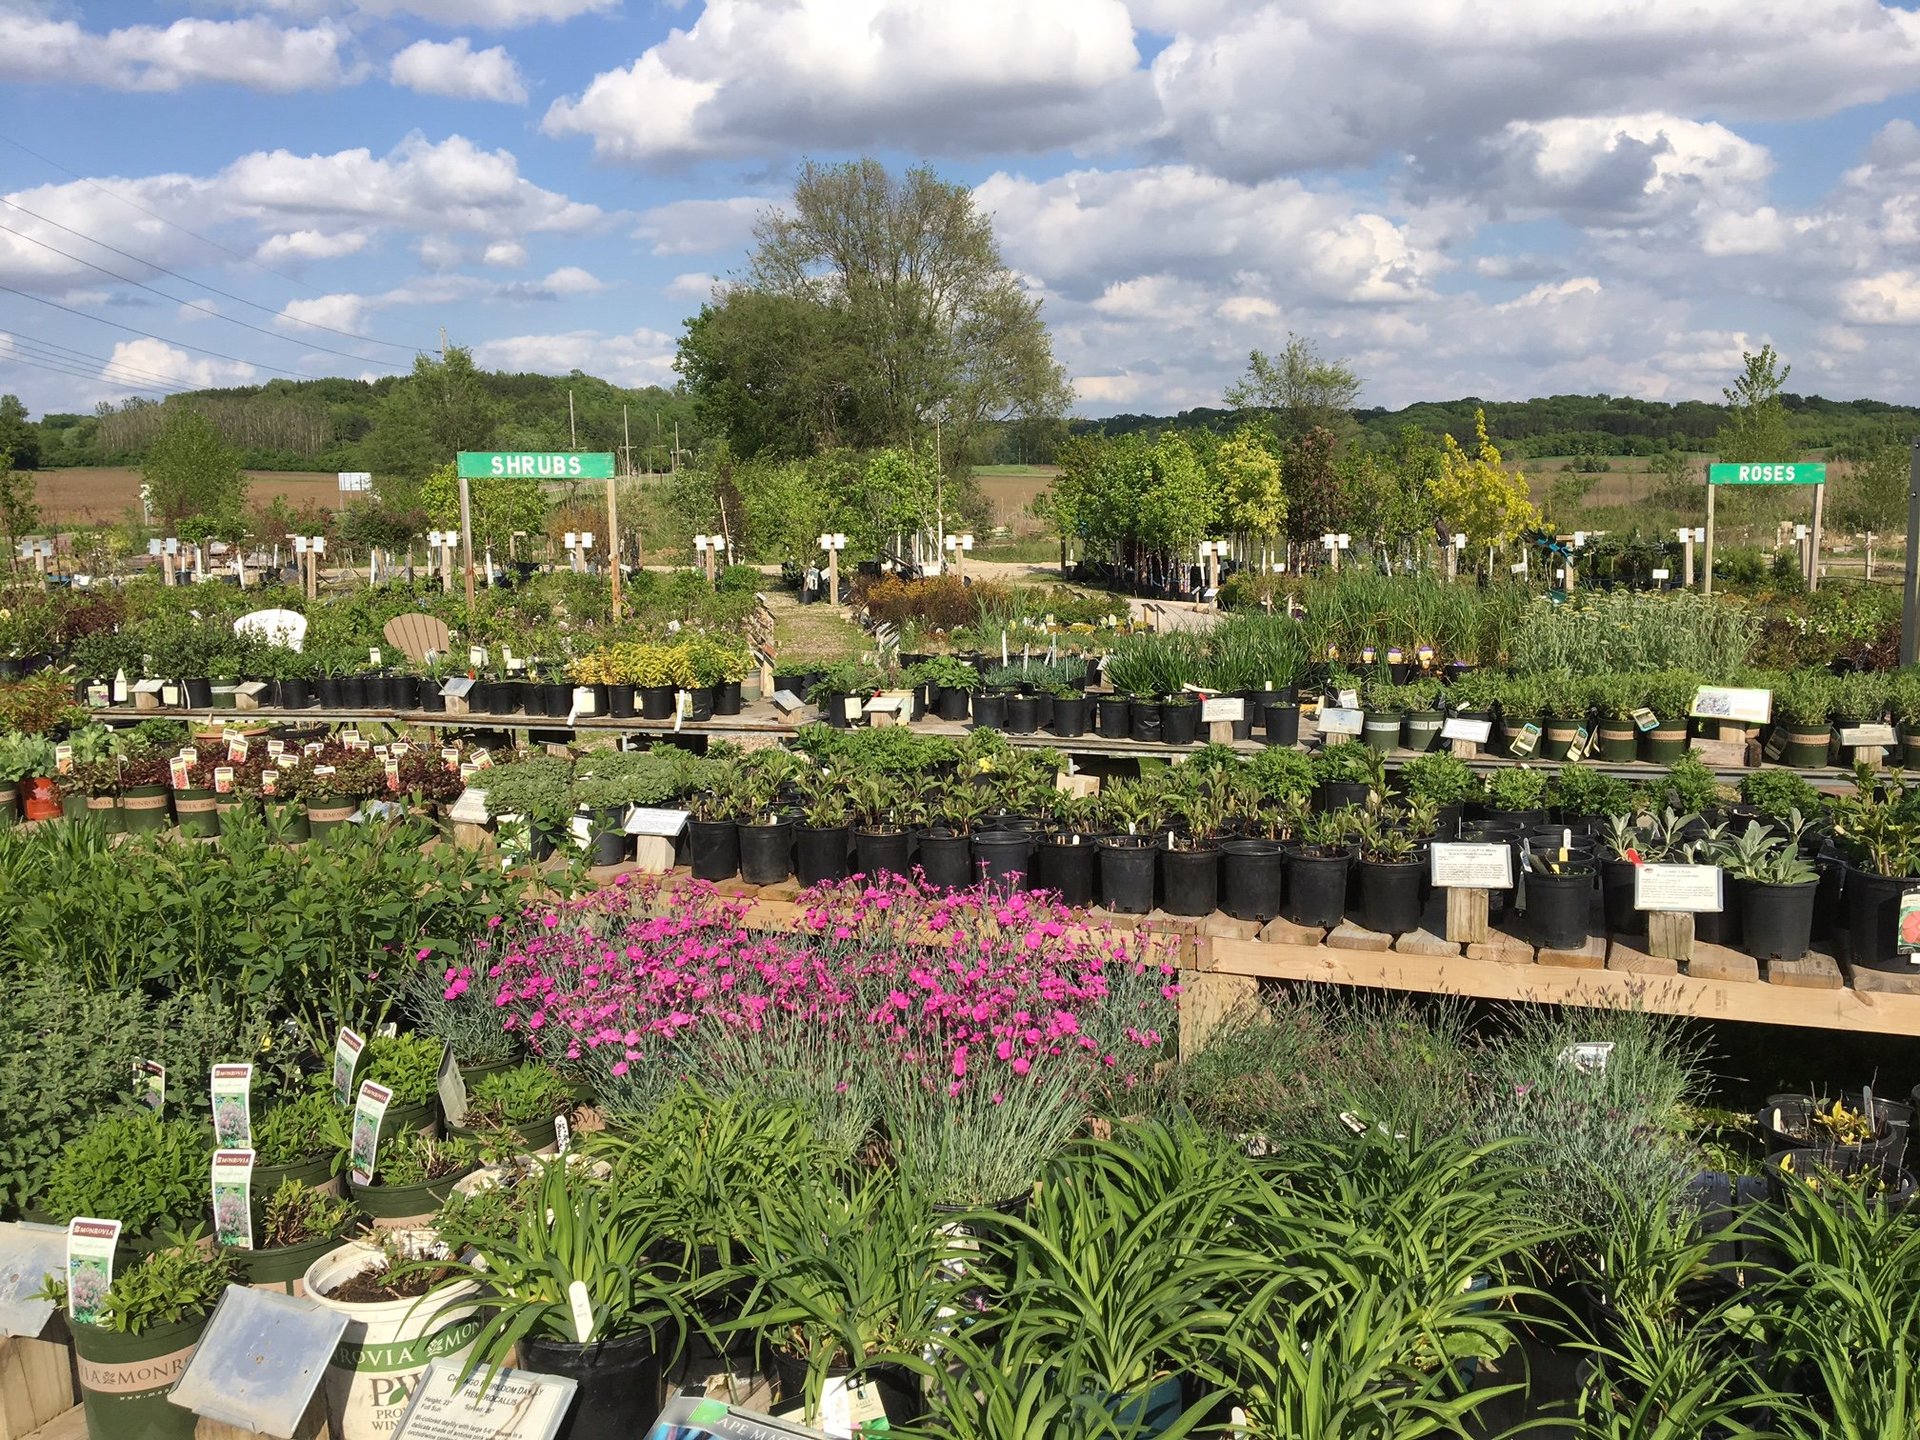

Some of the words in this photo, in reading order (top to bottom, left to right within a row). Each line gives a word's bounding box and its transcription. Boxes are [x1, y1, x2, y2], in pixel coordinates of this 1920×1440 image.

[491, 455, 581, 475] SHRUBS
[1739, 465, 1796, 482] ROSES
[79, 1226, 113, 1236] MONROVIA
[118, 1355, 188, 1385] MONR
[447, 1373, 480, 1387] CHAGO
[481, 1380, 517, 1394] IRLOOM
[376, 1407, 406, 1420] PRO
[714, 1417, 749, 1436] APE
